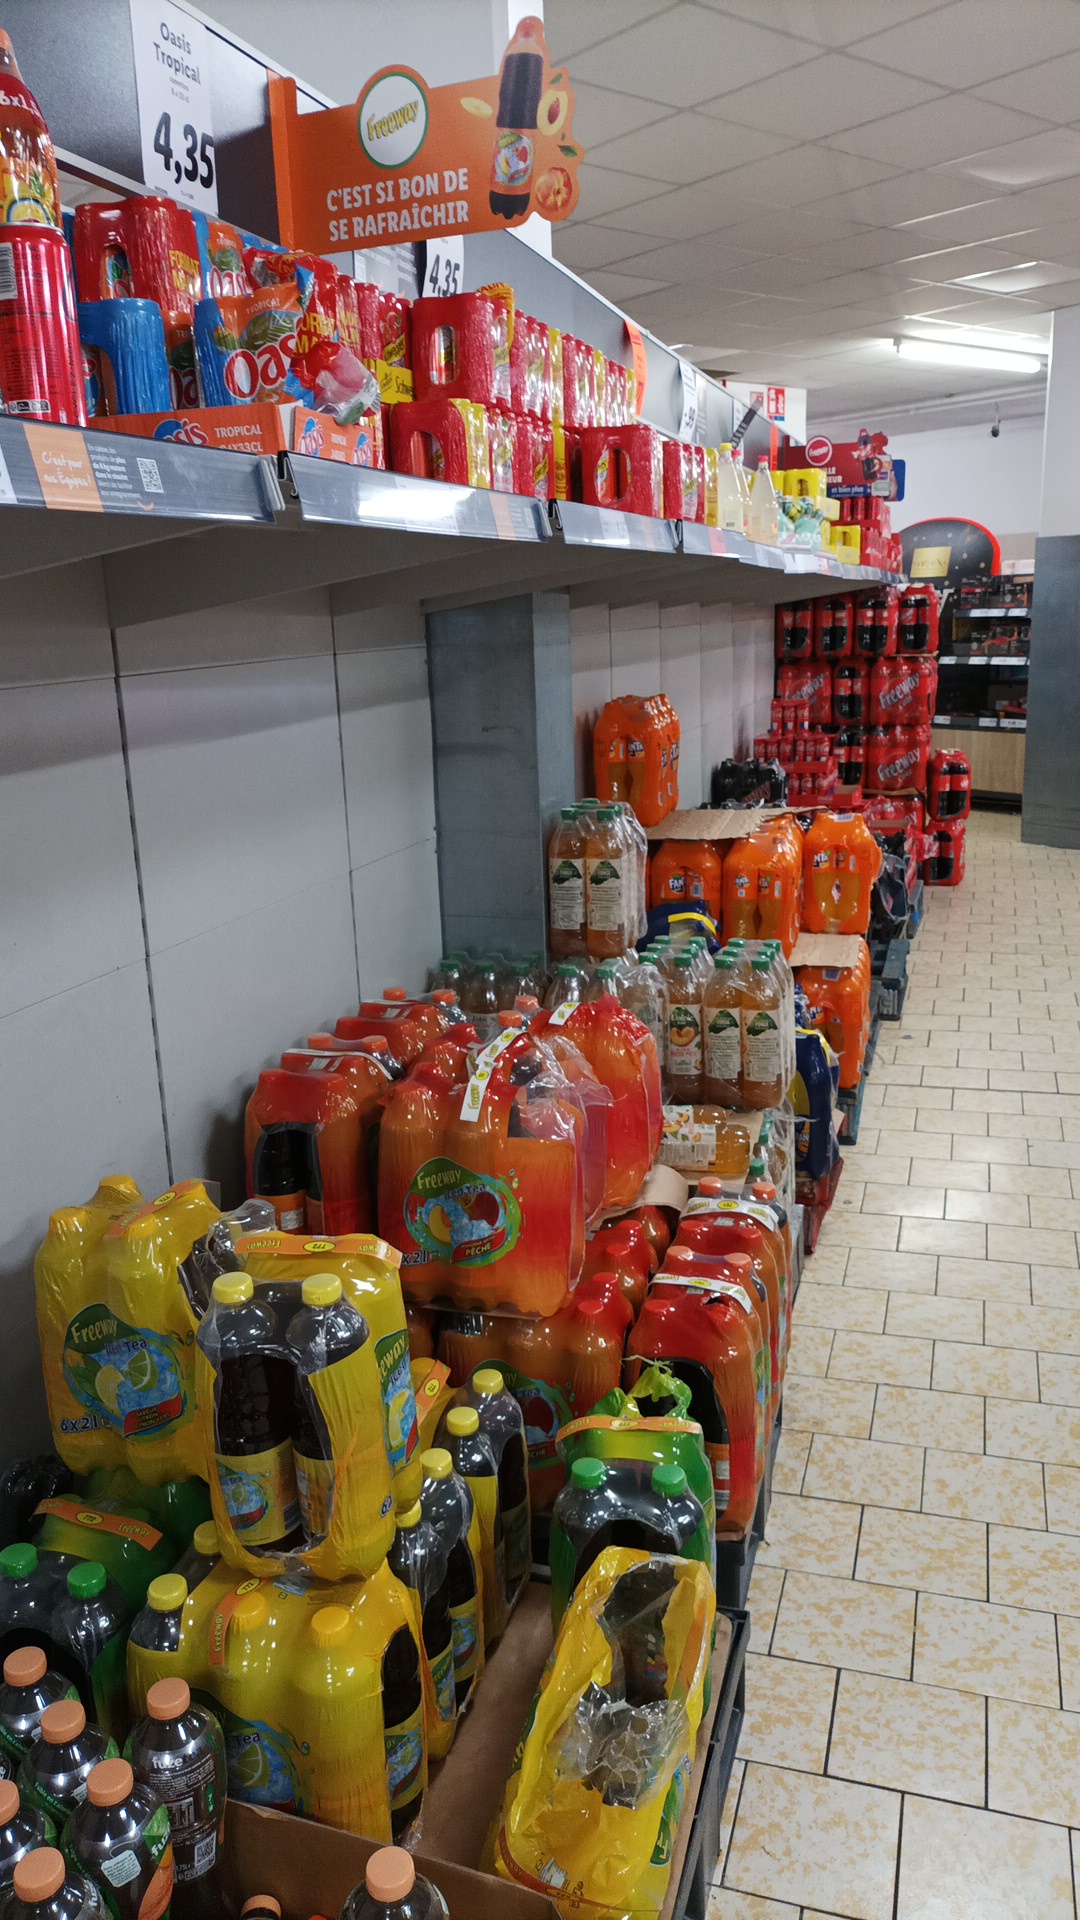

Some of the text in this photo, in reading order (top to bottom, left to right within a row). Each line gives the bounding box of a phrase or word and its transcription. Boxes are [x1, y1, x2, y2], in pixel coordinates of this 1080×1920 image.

[160, 21, 192, 55] Oasis
[152, 42, 202, 86] Tropical
[367, 99, 419, 142] Freeway
[153, 111, 216, 189] 4,35
[326, 167, 470, 212] C'EST SI BON DE
[328, 199, 470, 242] SE RAFRAÎCHIR
[214, 424, 263, 440] TROPICAL
[879, 671, 921, 710] Freeway
[877, 747, 921, 782] Freeway
[417, 1168, 462, 1191] Freeway
[444, 1182, 488, 1200] Iced Tea
[245, 1239, 281, 1251] Freeway
[465, 1242, 492, 1257] PÊCHE
[70, 1318, 118, 1344] Freeway
[125, 1338, 148, 1352] Tea
[117, 1523, 152, 1536] Freeway
[213, 1613, 224, 1652] Freeway
[235, 1731, 262, 1747] Tea
[152, 1756, 184, 1770] fuze
[46, 1794, 54, 1802] en
